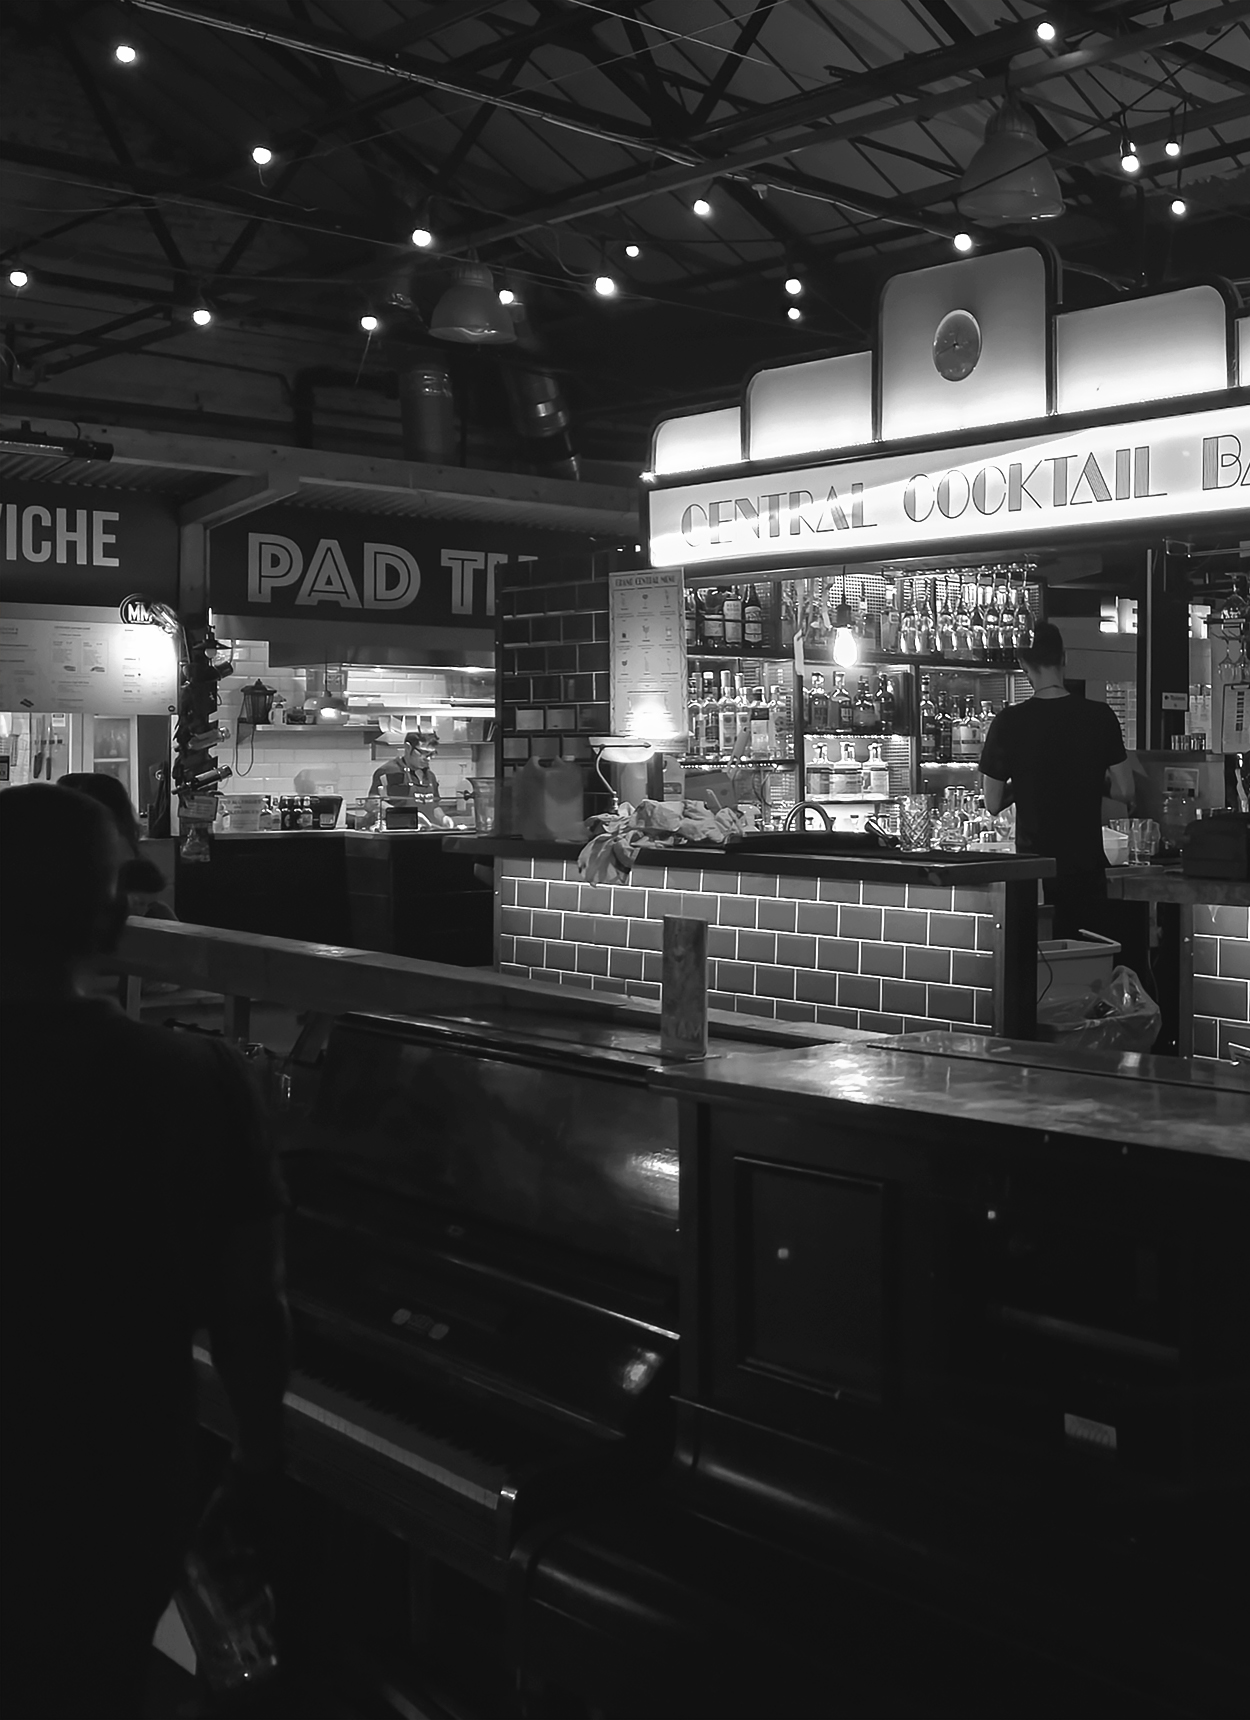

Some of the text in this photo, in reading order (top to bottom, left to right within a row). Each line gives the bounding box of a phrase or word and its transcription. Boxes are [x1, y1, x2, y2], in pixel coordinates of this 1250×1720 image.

[0, 503, 119, 567] ICHE
[681, 482, 877, 547] CENTRAL
[903, 446, 1167, 522] COCKTAIL
[248, 532, 421, 610] PAD
